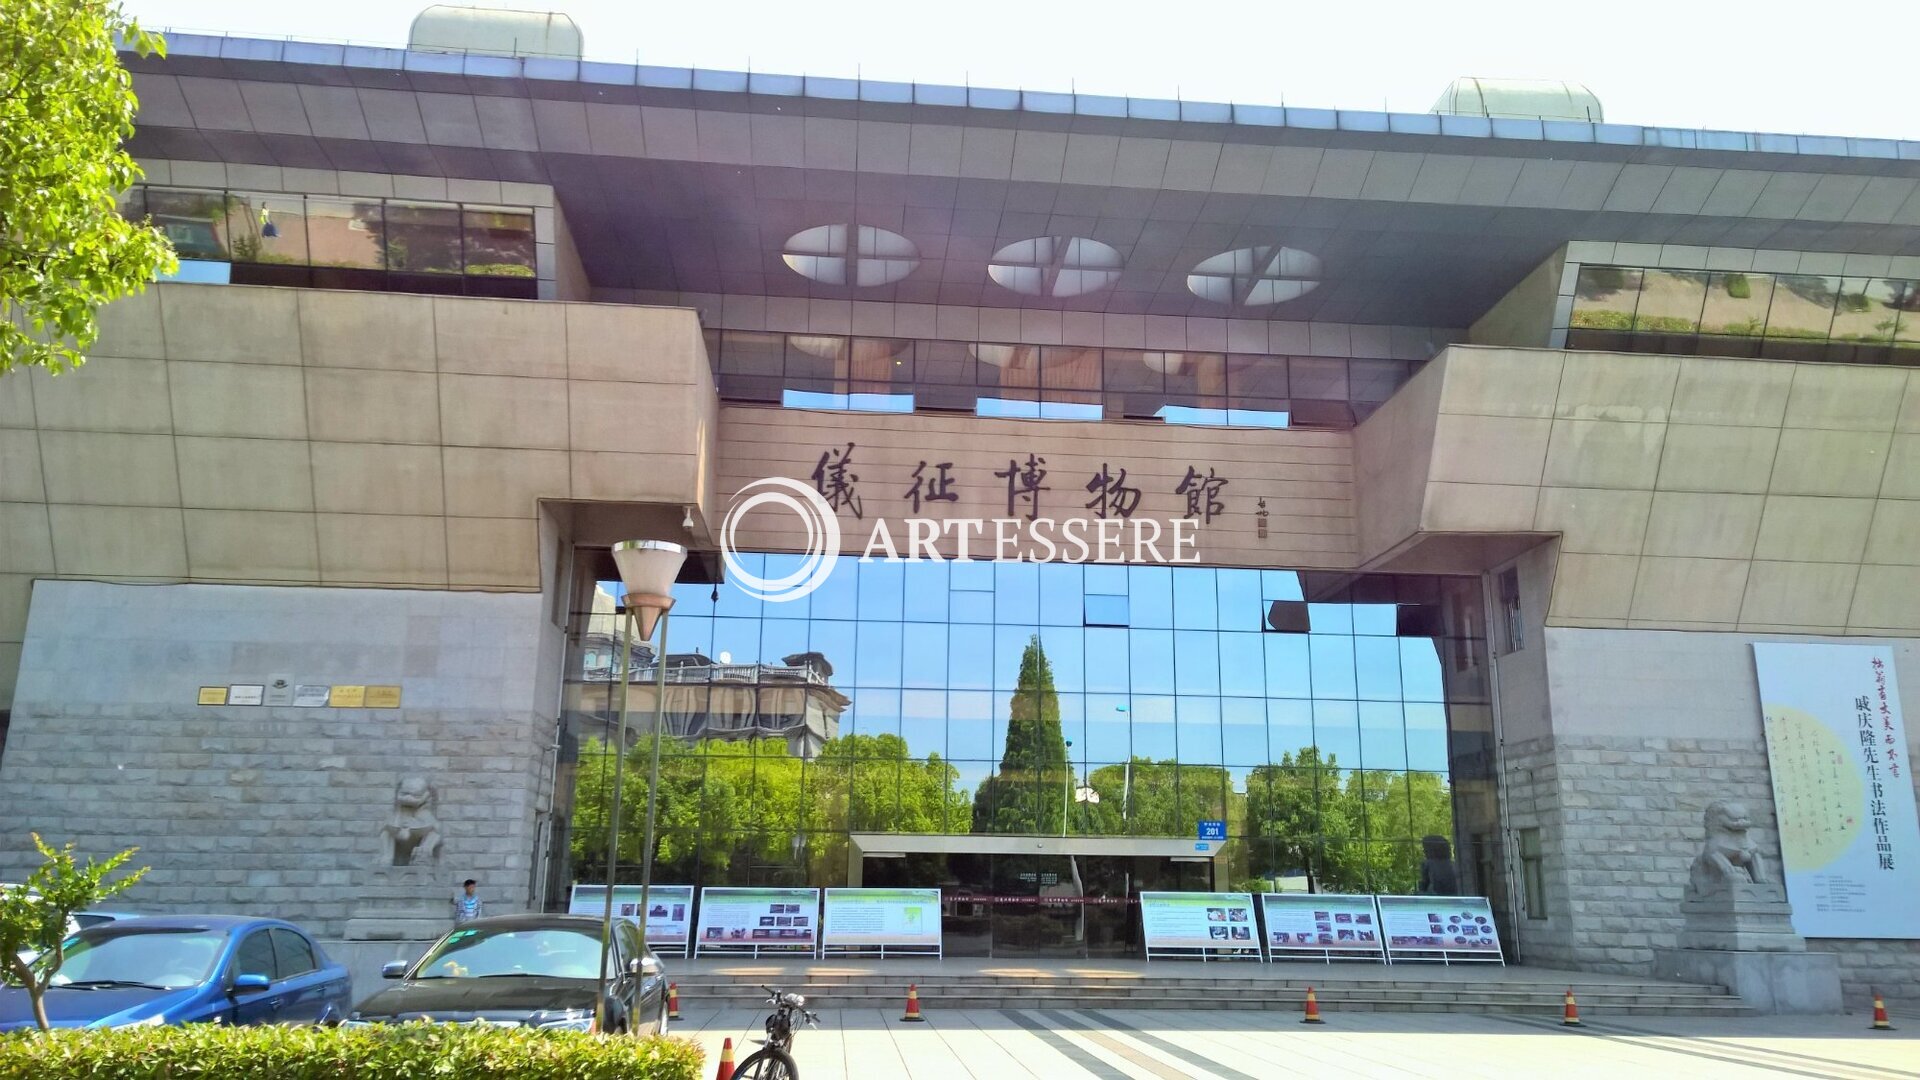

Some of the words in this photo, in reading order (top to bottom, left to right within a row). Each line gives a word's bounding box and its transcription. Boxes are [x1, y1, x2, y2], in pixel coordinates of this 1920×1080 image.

[811, 442, 1228, 525] 儀征博物館
[1206, 827, 1219, 836] 201
